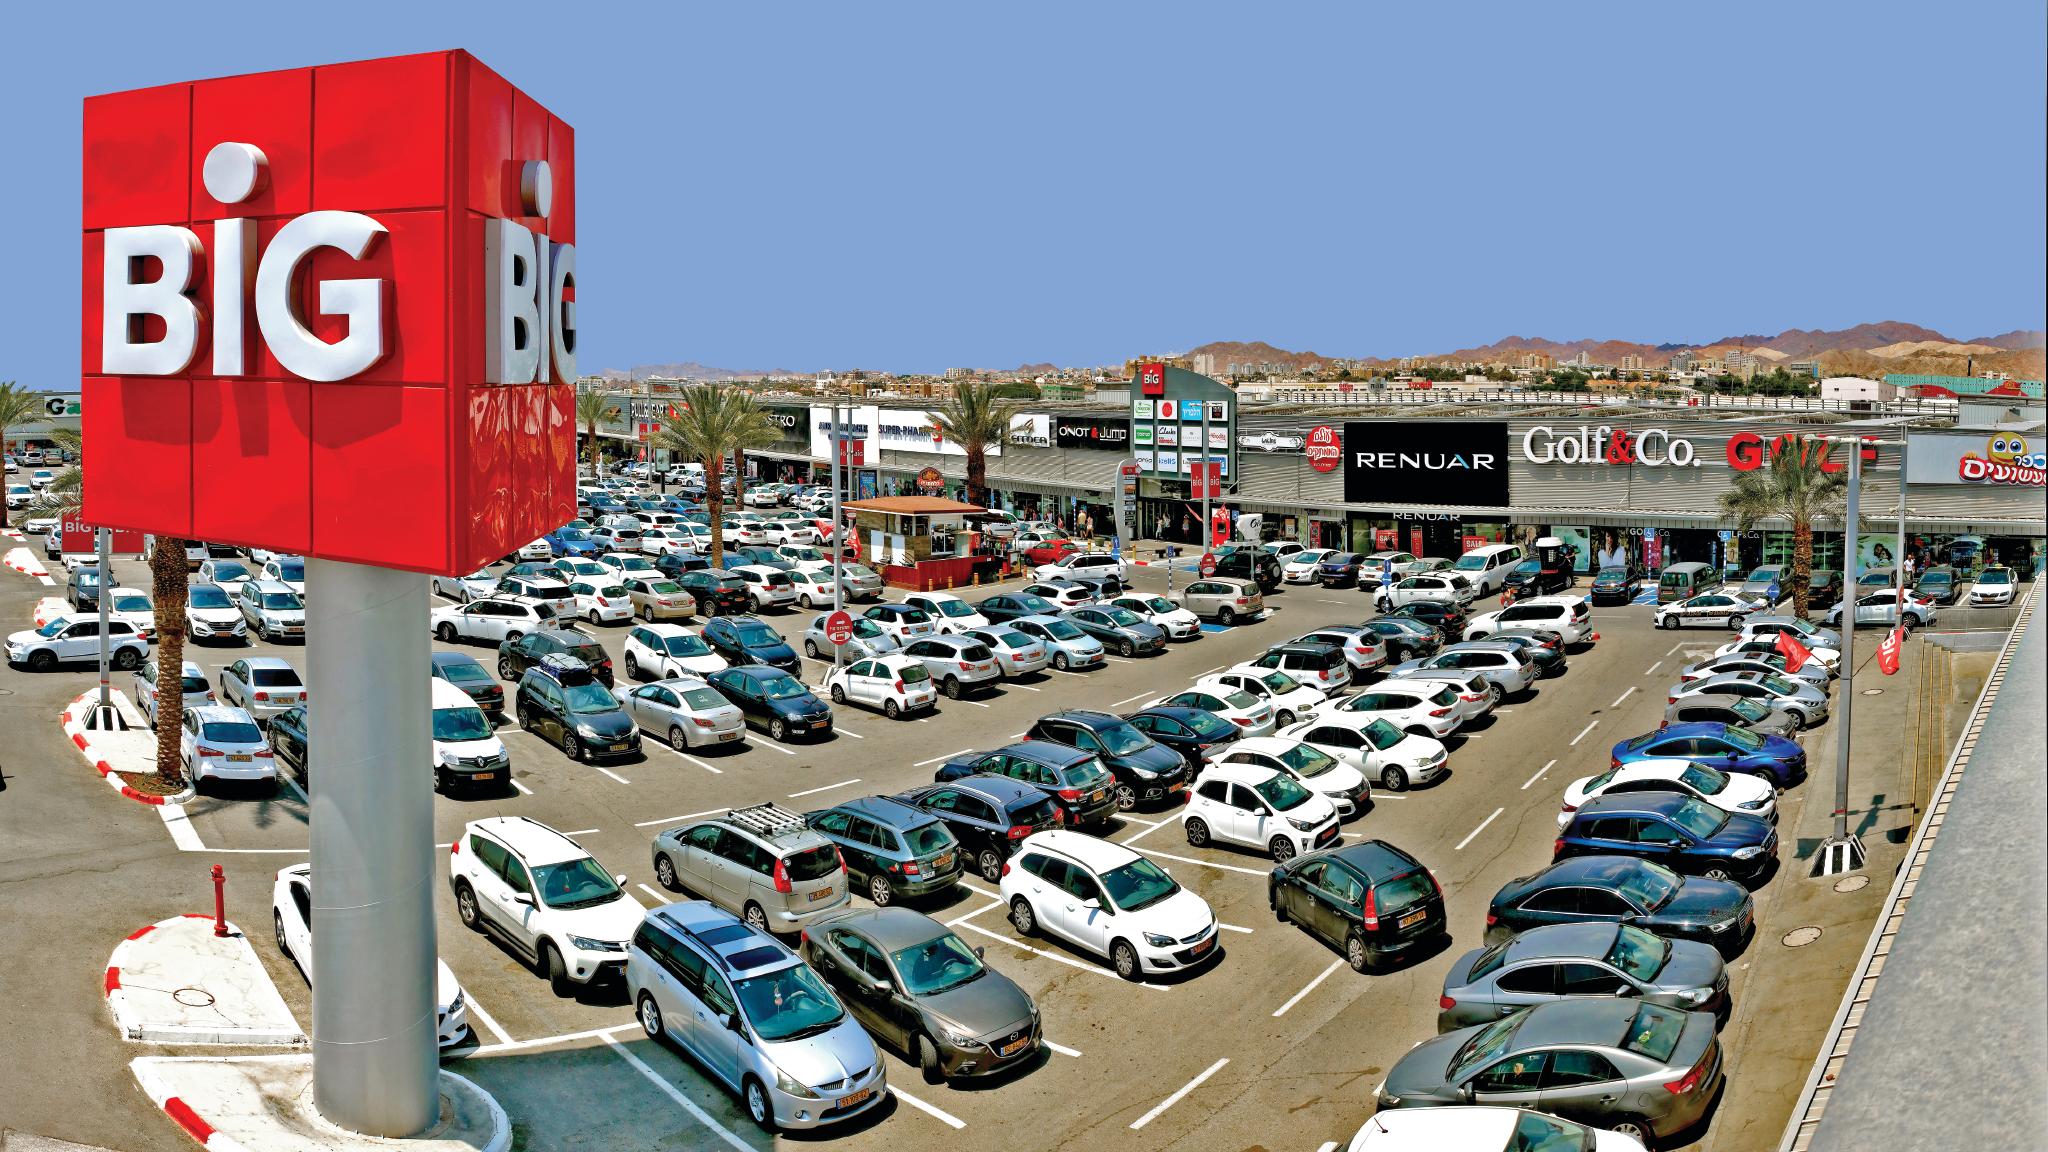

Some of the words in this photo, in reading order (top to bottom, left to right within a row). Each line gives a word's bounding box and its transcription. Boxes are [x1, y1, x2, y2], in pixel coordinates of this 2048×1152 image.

[102, 142, 392, 381] BIG
[487, 160, 576, 384] BIG
[1144, 370, 1159, 384] BIG
[1523, 425, 1702, 467] Golf&Co.
[1356, 452, 1495, 470] RENUAR
[1964, 460, 2046, 484] עשועים
[65, 517, 92, 533] BIG
[1393, 512, 1460, 521] RENUAR
[1379, 535, 1395, 543] SA
[1629, 527, 1670, 537] GO&Co.
